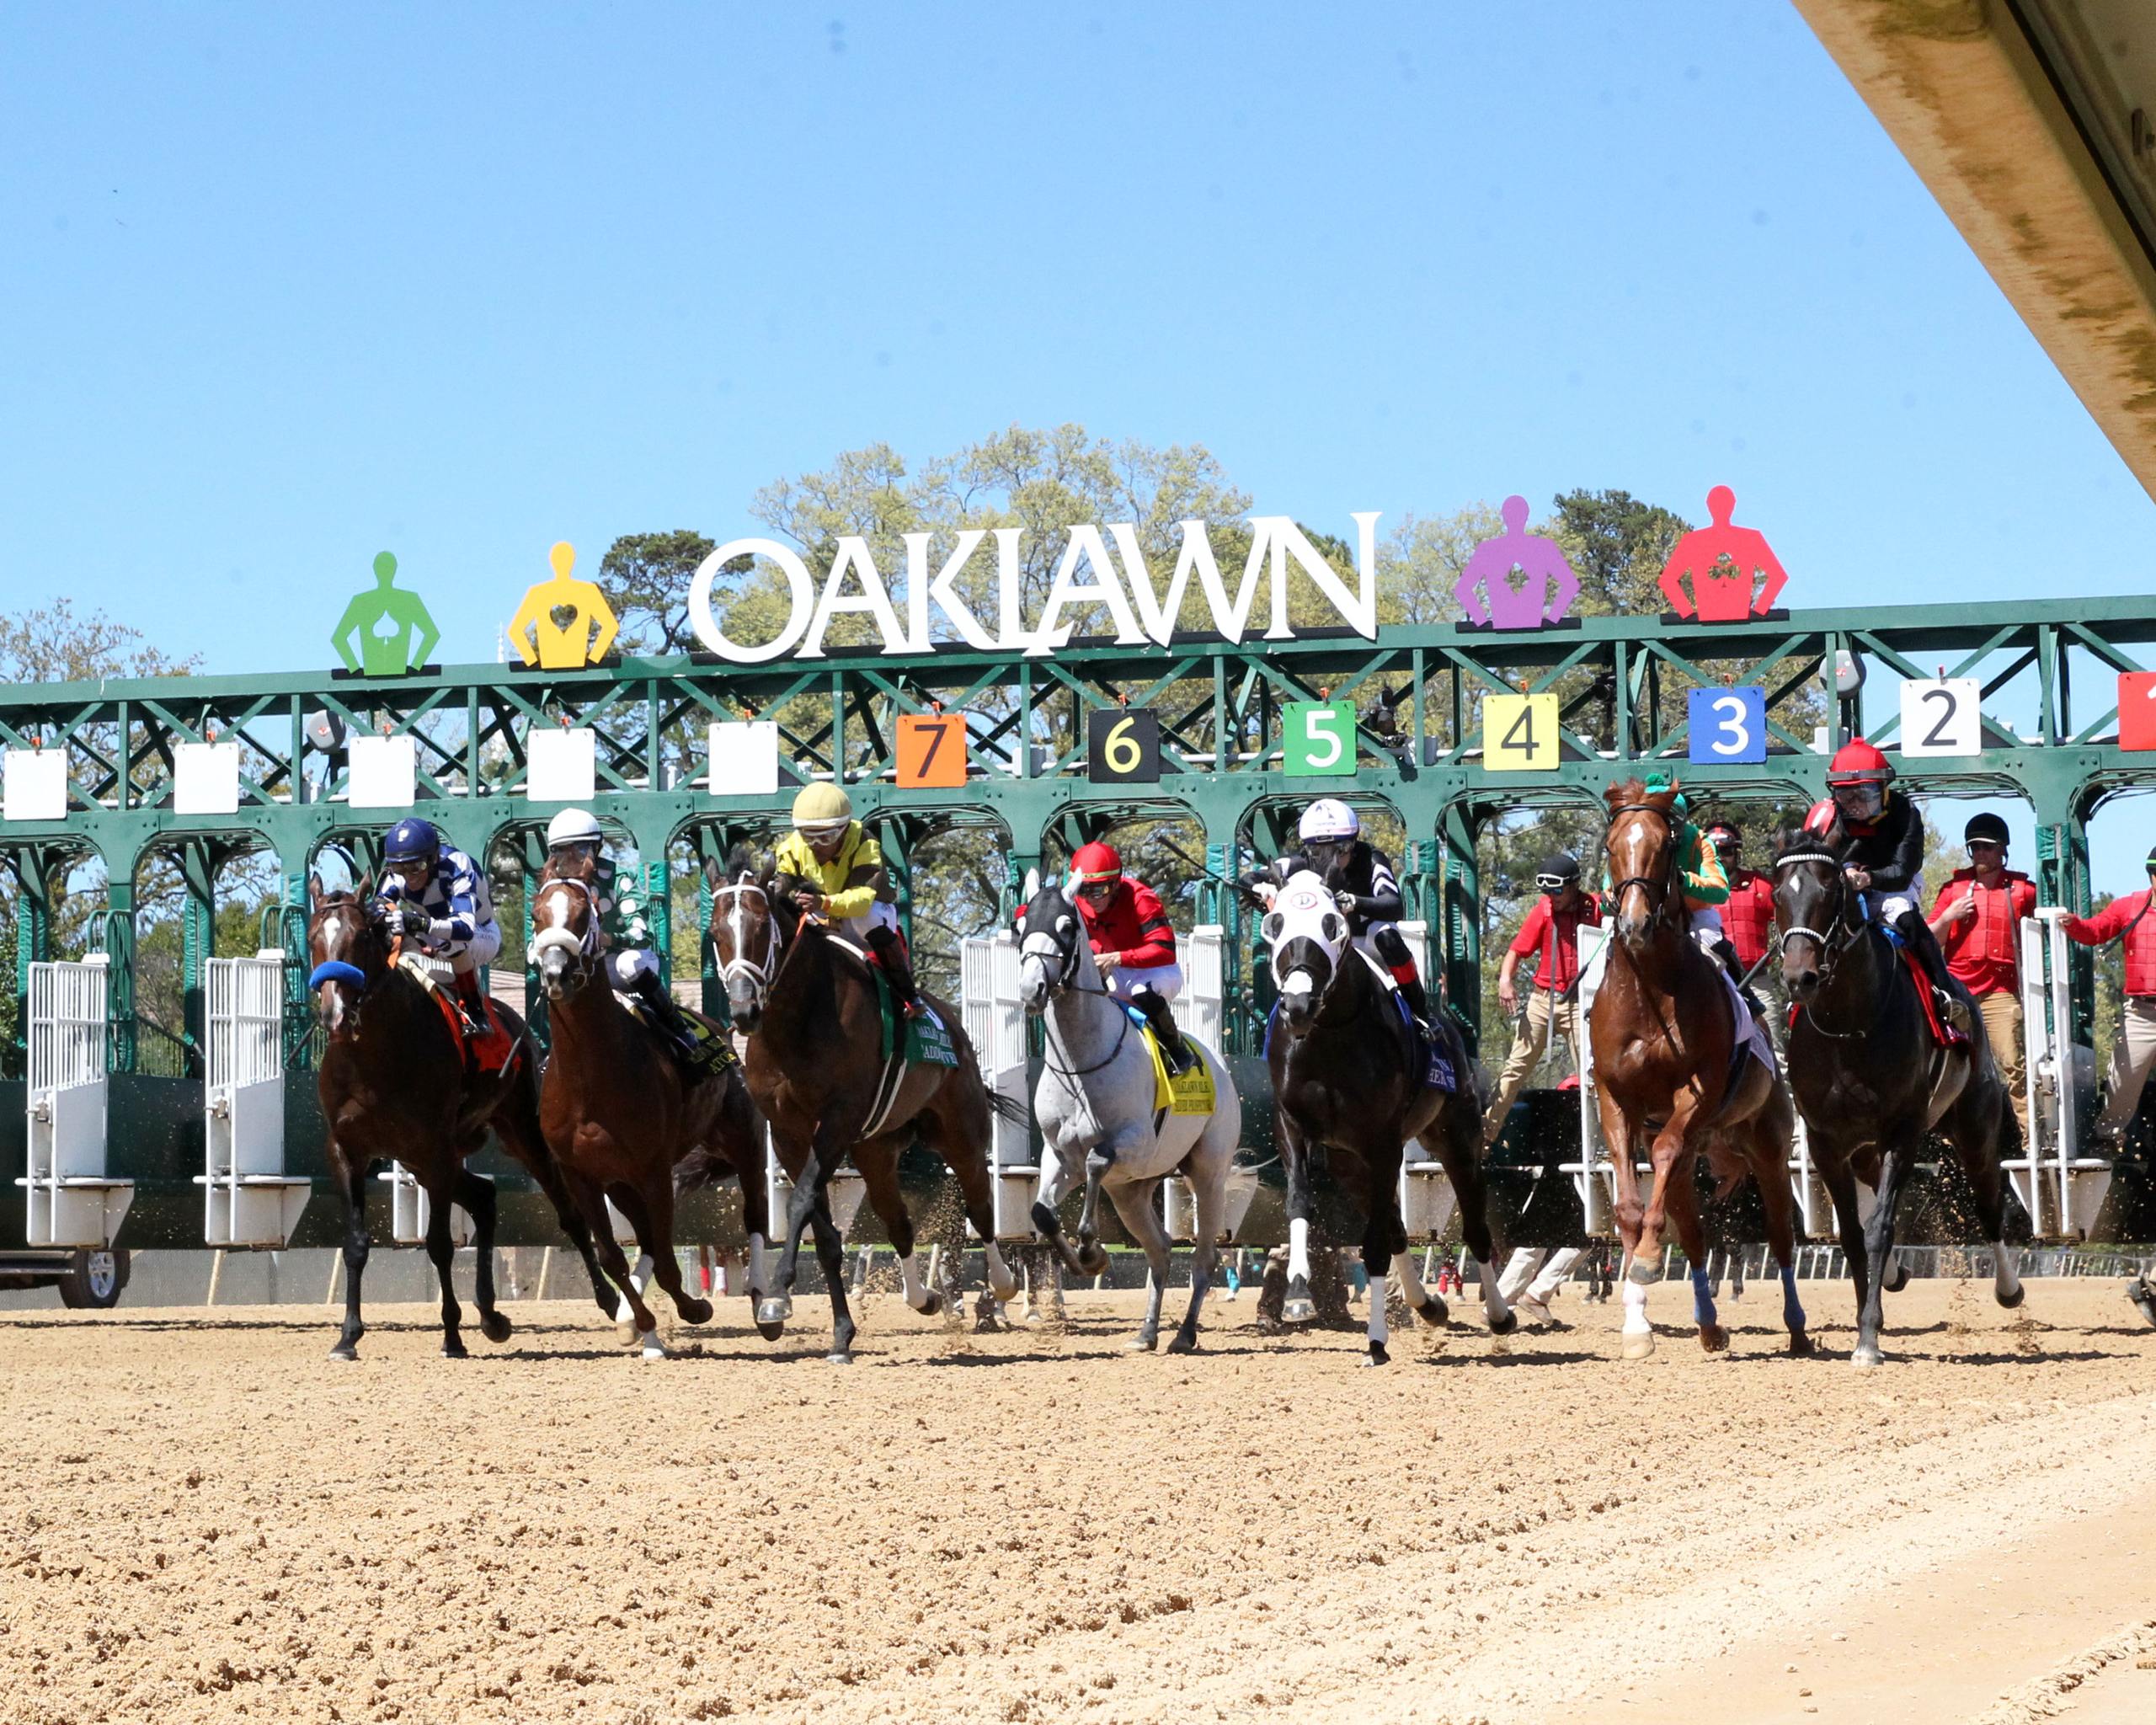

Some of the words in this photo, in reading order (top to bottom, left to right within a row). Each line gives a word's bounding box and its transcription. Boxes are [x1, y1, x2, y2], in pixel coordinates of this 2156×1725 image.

[688, 510, 1383, 664] OAKLAWN
[1104, 716, 1142, 774] 6
[1305, 709, 1343, 768] 5
[1501, 705, 1540, 761] 4
[1710, 696, 1749, 756] 3
[1921, 689, 1957, 747] 2
[914, 724, 947, 778] 7
